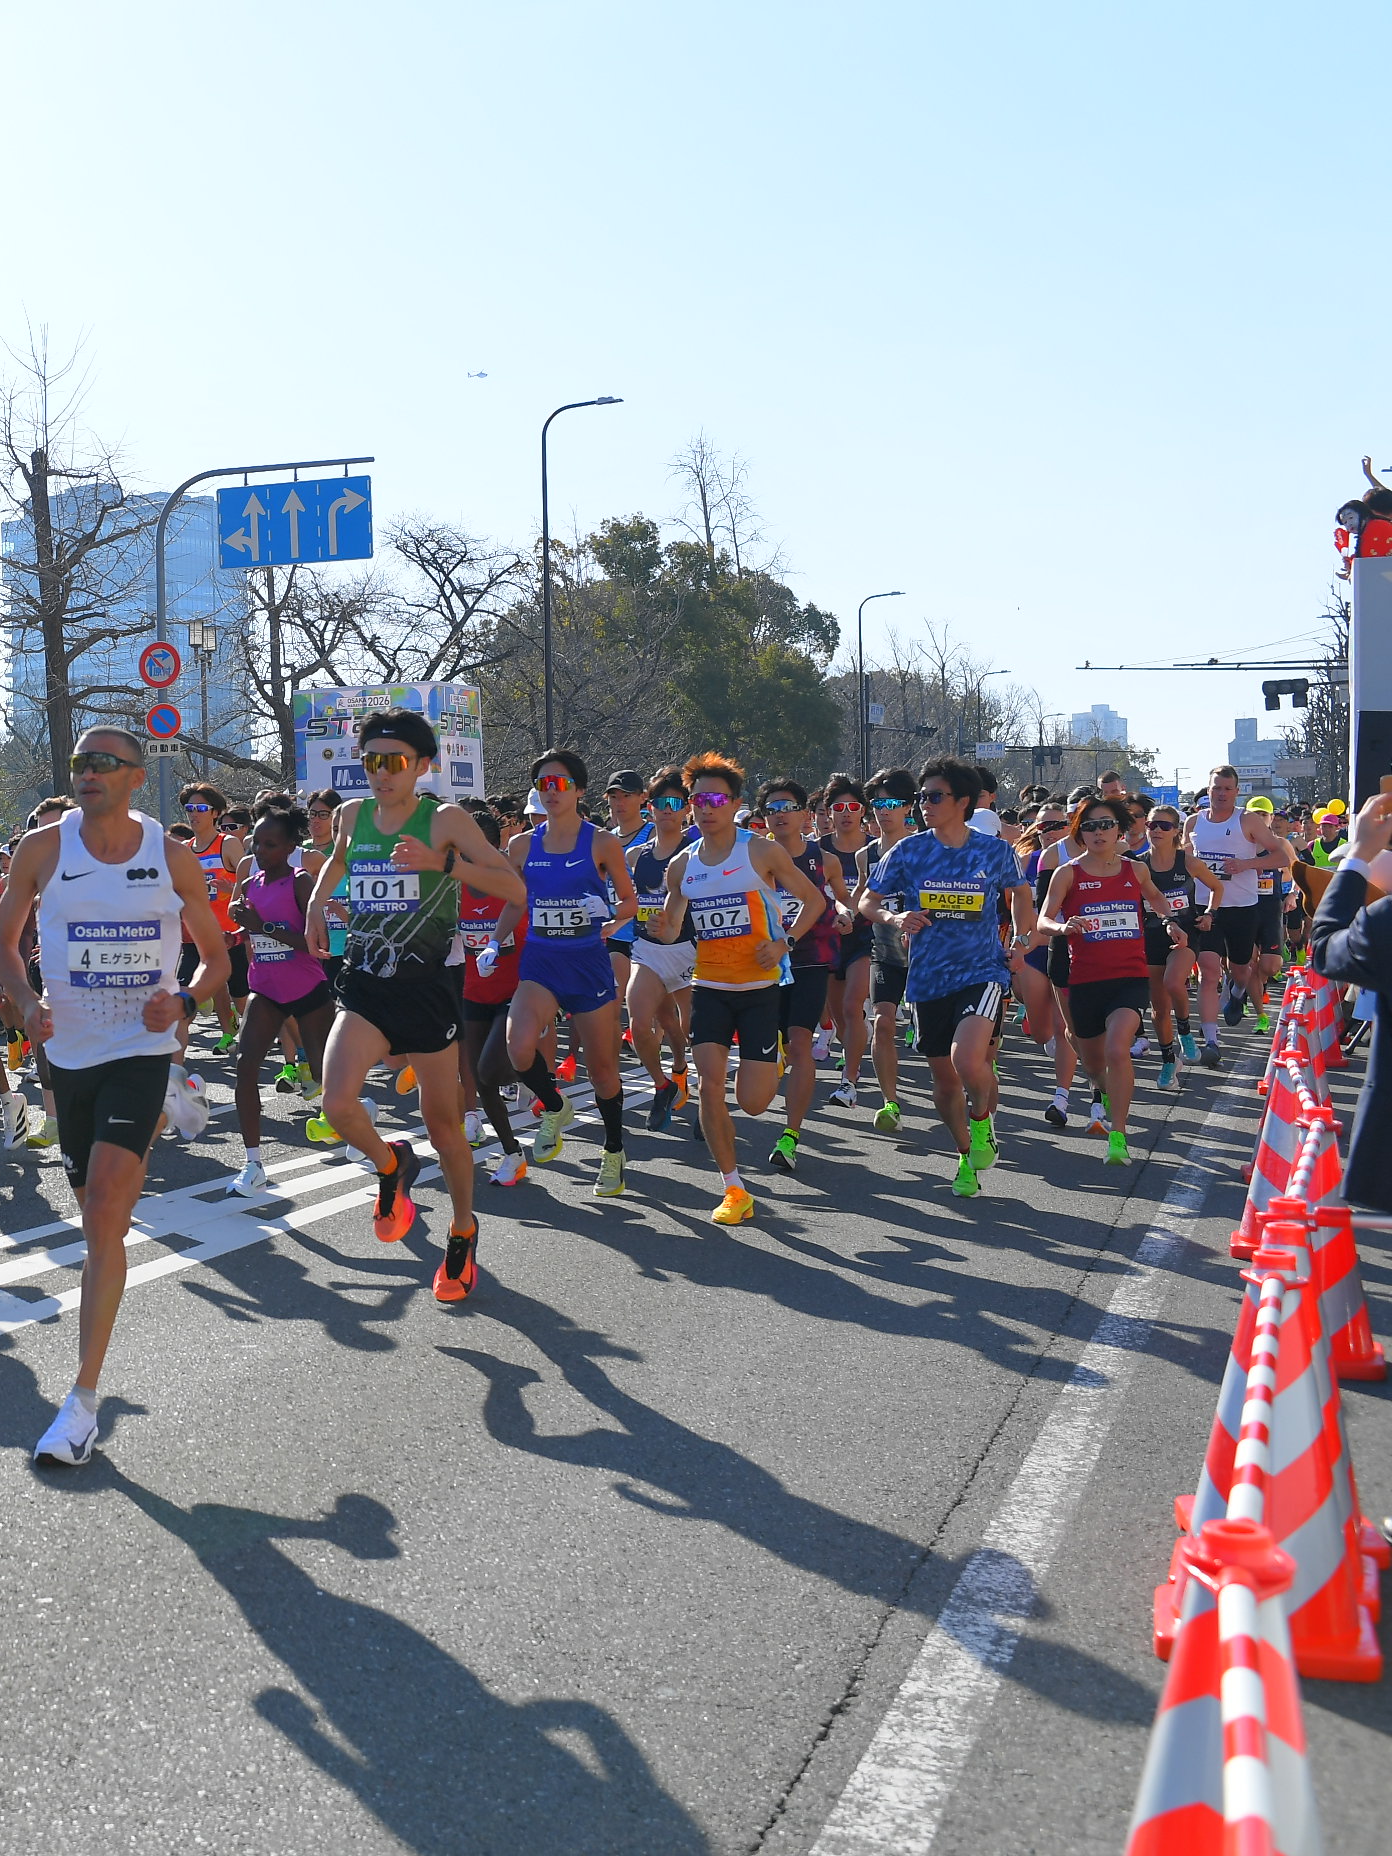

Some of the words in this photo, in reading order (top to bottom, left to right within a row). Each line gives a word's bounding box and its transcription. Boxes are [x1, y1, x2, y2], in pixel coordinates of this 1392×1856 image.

[368, 696, 390, 707] 2026
[149, 743, 179, 753] 自動車
[355, 778, 369, 786] Osa
[352, 862, 381, 873] Osaka
[355, 879, 405, 899] 101
[924, 880, 952, 889] Osaka
[953, 881, 981, 890] Metro
[1079, 881, 1102, 891] 京セラ
[535, 899, 559, 907] Osaka
[691, 900, 715, 909] Osaka
[716, 896, 742, 906] Metro
[929, 893, 974, 905] PACE8
[641, 907, 659, 916] PAC
[1084, 904, 1111, 913] Osaka
[1112, 903, 1134, 911] Metro
[539, 911, 584, 926] 115
[697, 909, 741, 929] 107
[461, 922, 483, 930] Osaka
[484, 921, 497, 929] Met
[75, 925, 117, 938] Osaka
[119, 925, 156, 938] Metro
[80, 949, 91, 969] 4
[100, 952, 151, 965] E.ゲラント
